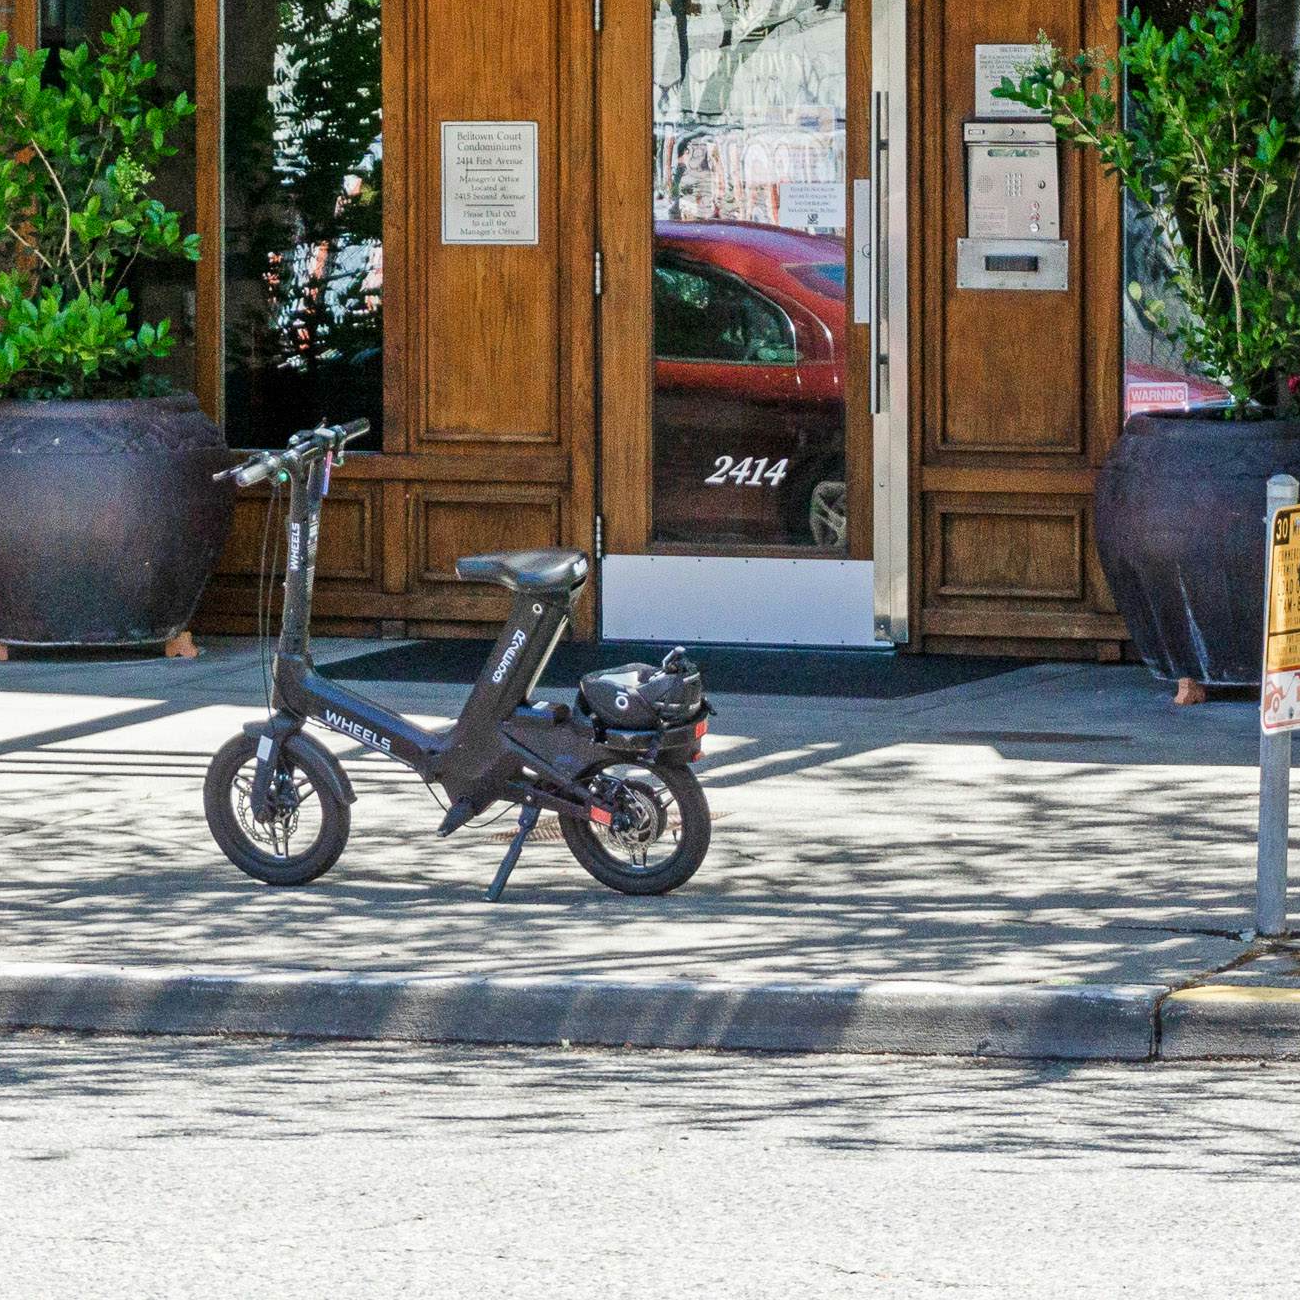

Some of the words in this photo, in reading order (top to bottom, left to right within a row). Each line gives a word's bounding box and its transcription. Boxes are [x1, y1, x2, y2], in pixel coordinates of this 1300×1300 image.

[457, 131, 493, 141] Belltown
[497, 131, 522, 141] Court
[457, 142, 522, 151] Condominiums
[476, 156, 492, 165] First
[495, 156, 523, 165] Avenue
[1131, 389, 1185, 401] WARNING
[704, 455, 789, 486] 2414
[1276, 518, 1289, 540] 30
[290, 522, 301, 572] WHEELS
[326, 709, 392, 751] WHEELS
